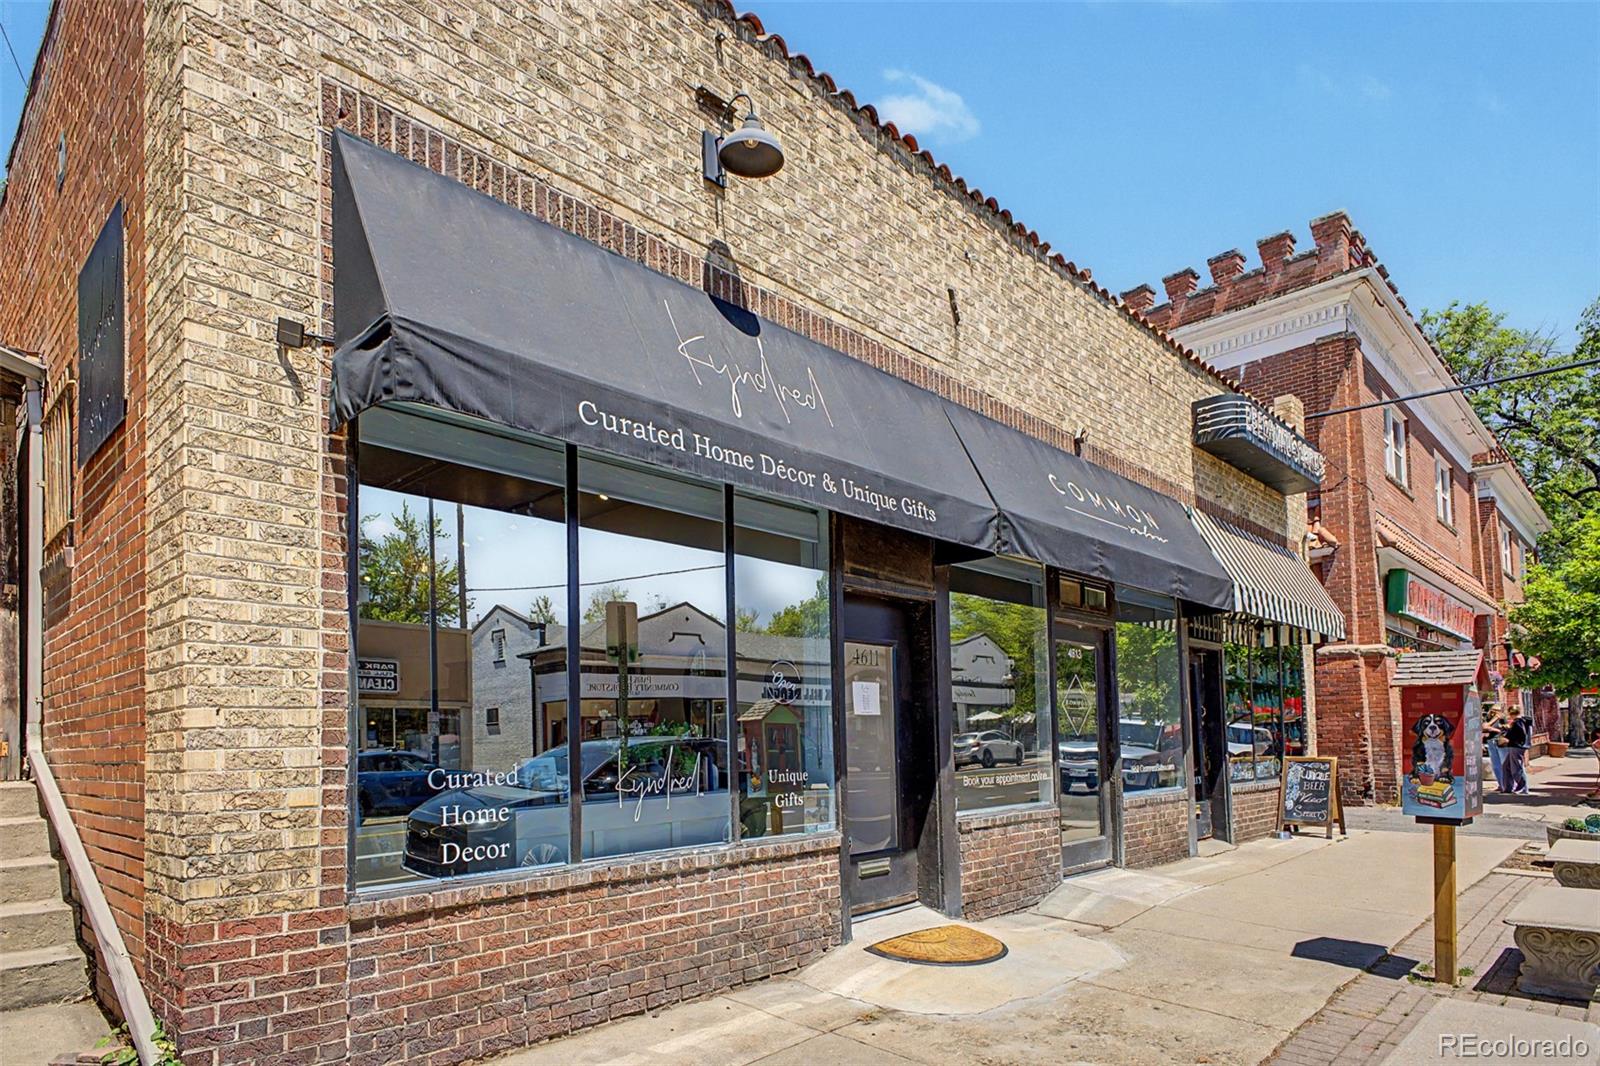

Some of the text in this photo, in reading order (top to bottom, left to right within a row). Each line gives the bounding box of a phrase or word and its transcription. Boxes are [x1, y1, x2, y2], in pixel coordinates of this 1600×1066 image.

[578, 400, 937, 523] Curated Home Décor & Unique Gifts
[1048, 473, 1160, 530] COMMON
[852, 648, 880, 667] 4611
[772, 670, 797, 691] Open
[427, 763, 520, 790] Curated
[769, 769, 809, 786] Unique
[963, 775, 980, 787] Book
[981, 776, 995, 788] your
[1303, 781, 1326, 791] BEER
[775, 792, 804, 808] Gifts
[440, 804, 510, 828] Home
[440, 841, 510, 865] Decor
